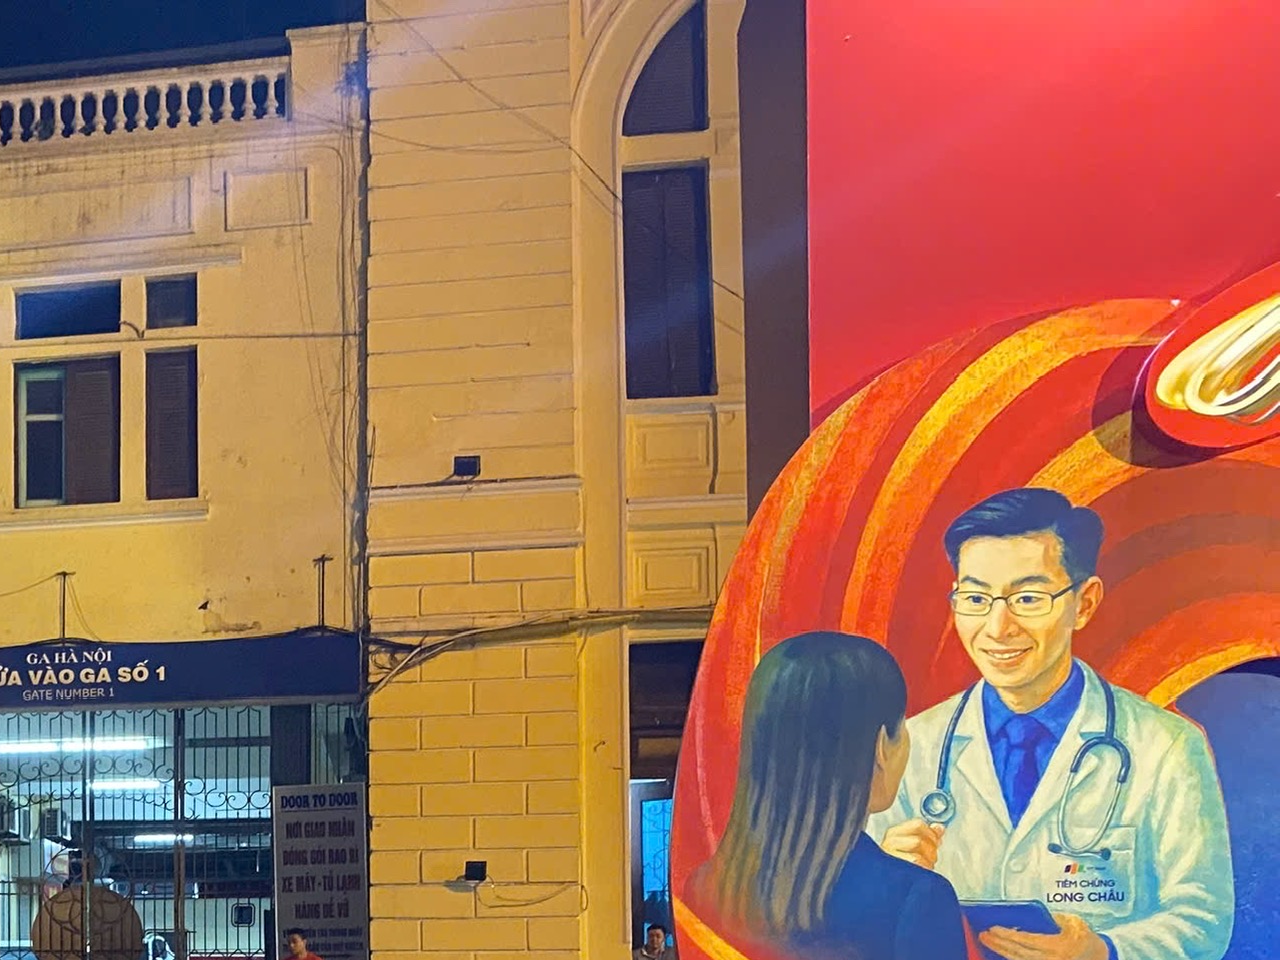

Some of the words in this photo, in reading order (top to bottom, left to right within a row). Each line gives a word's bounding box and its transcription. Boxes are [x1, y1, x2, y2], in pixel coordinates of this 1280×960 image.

[26, 652, 50, 664] GA
[54, 649, 78, 664] HÀ
[82, 647, 112, 666] NỘI
[28, 666, 75, 685] VÀO
[79, 667, 111, 684] GA
[118, 659, 149, 683] SỐ
[155, 666, 166, 681] 1
[22, 689, 53, 701] GATE
[55, 688, 105, 700] NUMBER
[109, 687, 115, 697] 1
[281, 795, 309, 808] DOOR
[312, 794, 326, 808] TO
[329, 792, 358, 806] DOOR
[282, 876, 293, 893] XE
[295, 872, 316, 892] MÁY
[1047, 892, 1084, 903] LONG
[1088, 889, 1124, 902] CHÂU
